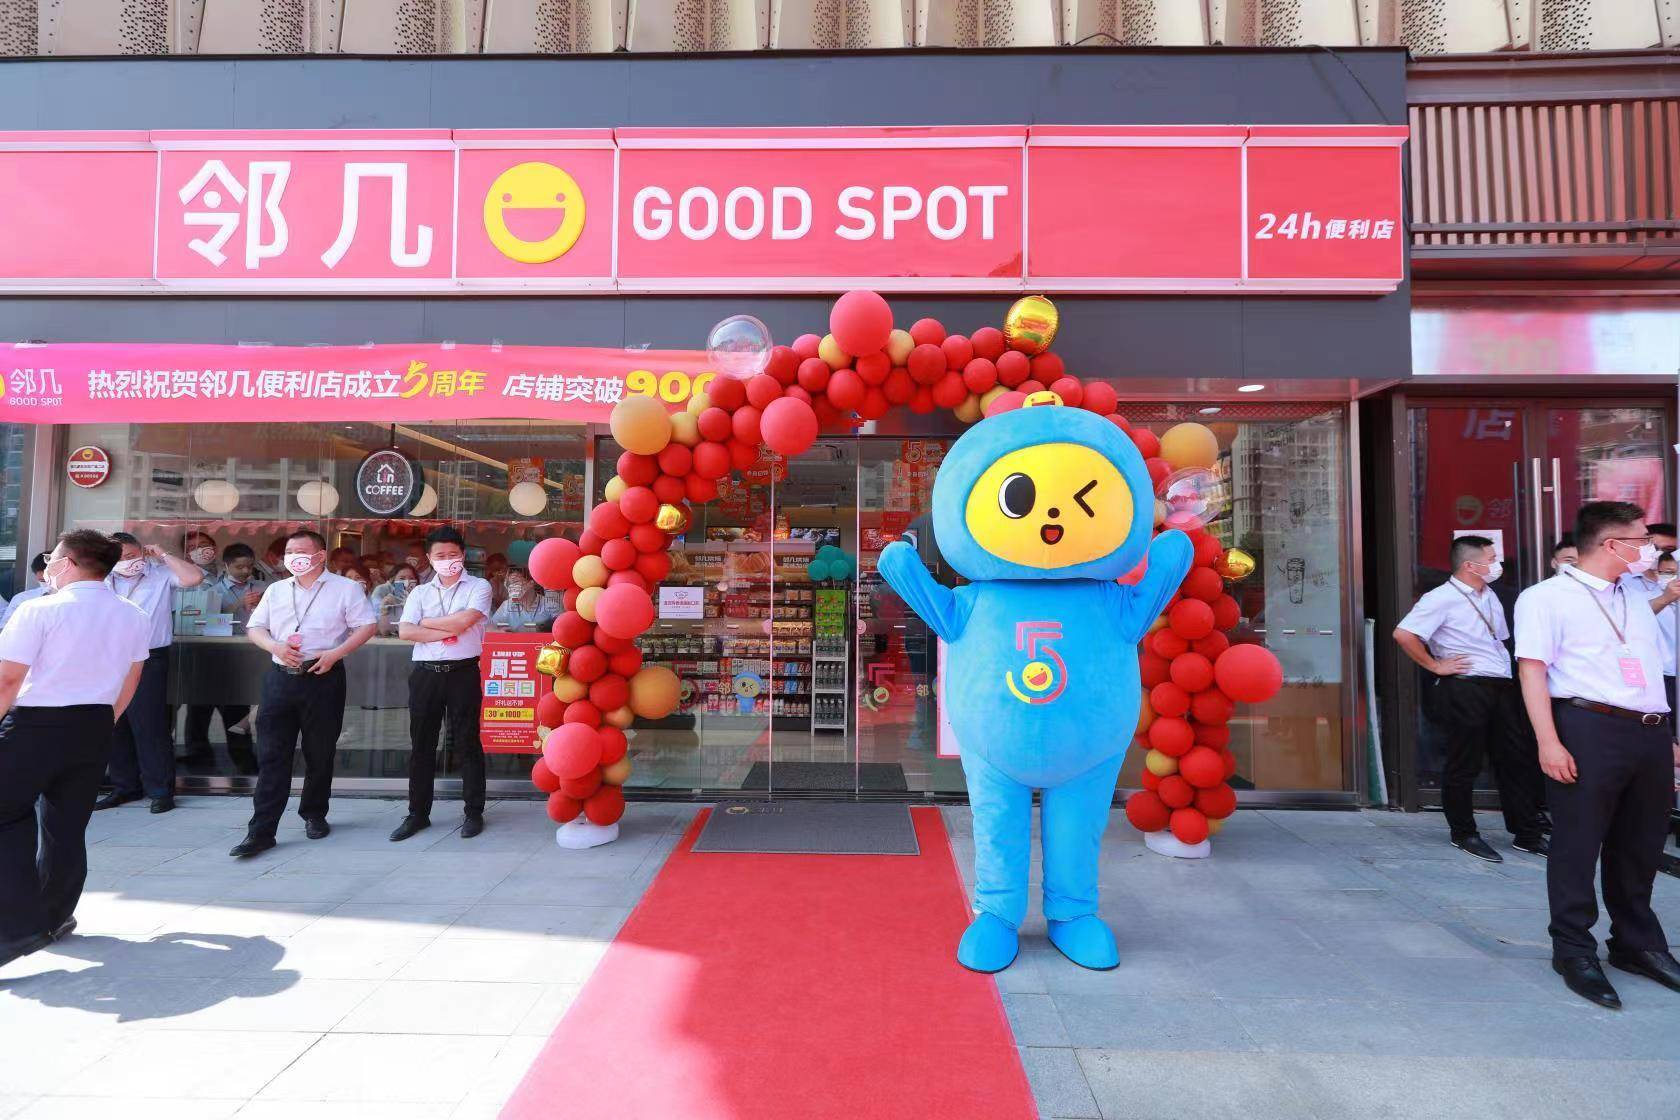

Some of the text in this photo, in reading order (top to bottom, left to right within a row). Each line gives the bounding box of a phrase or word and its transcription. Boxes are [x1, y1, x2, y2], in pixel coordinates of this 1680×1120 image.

[179, 159, 434, 270] 邻几
[632, 185, 1009, 241] GOOD SPOT
[1254, 211, 1396, 240] 24h便利店
[9, 368, 63, 396] 邻几
[9, 397, 63, 406] GOOD SPOT
[365, 484, 404, 496] COFFEE
[488, 659, 529, 679] 周三
[487, 681, 533, 695] 会员日
